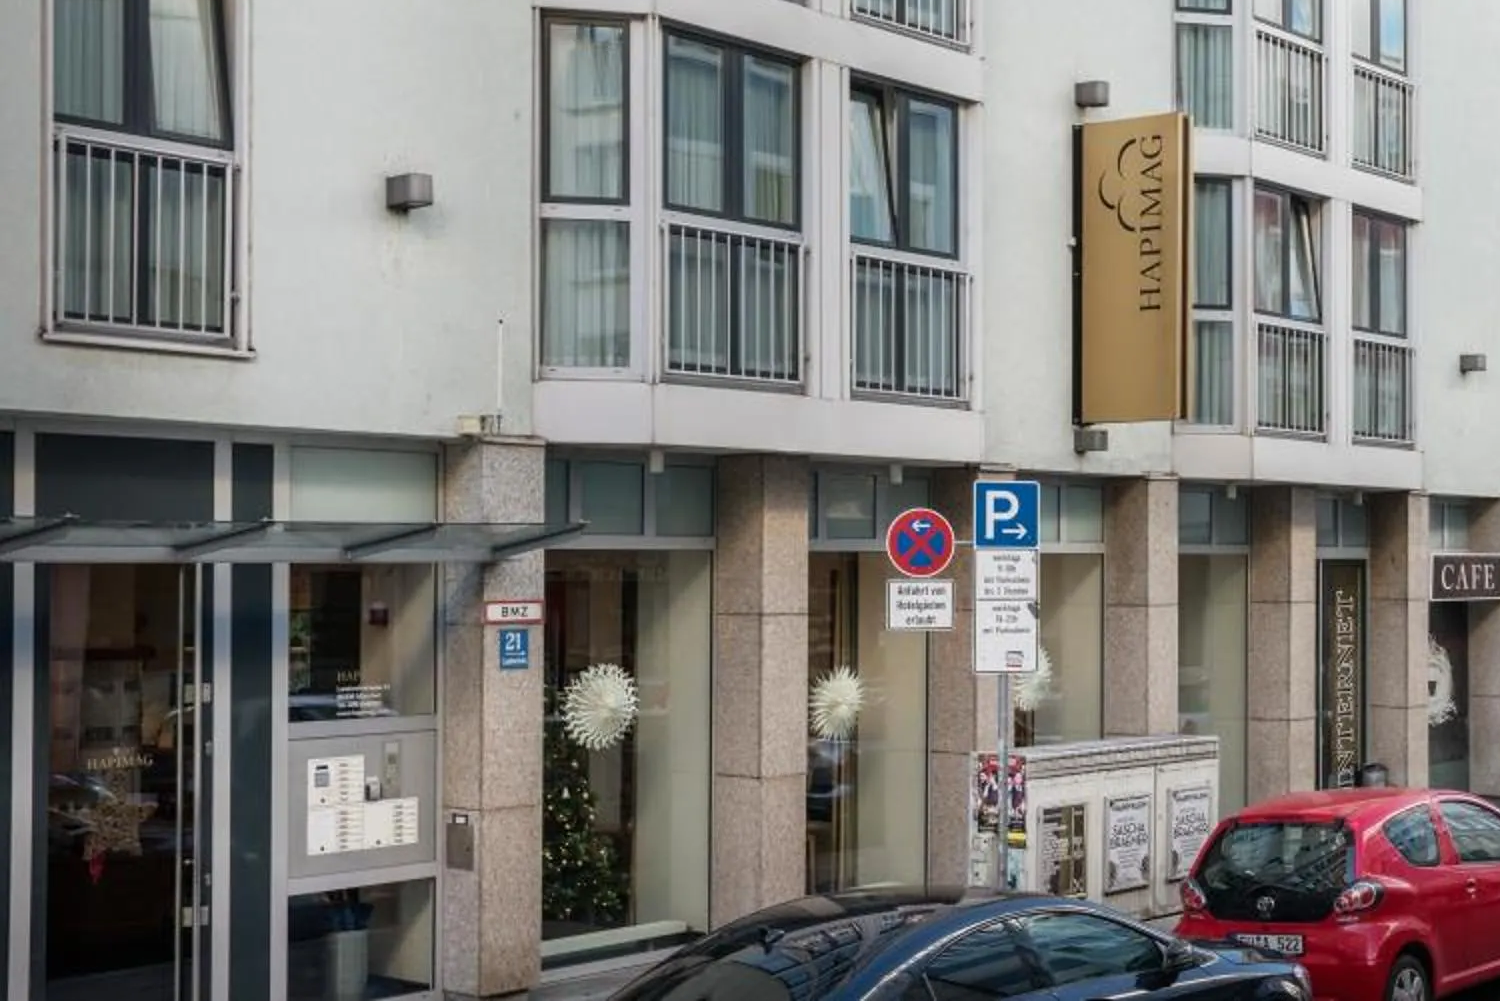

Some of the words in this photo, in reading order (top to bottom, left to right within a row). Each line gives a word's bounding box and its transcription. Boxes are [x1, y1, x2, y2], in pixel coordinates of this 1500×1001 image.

[1139, 134, 1164, 312] HAPIMAG
[985, 490, 1020, 540] P
[1441, 563, 1495, 590] CAFE
[501, 606, 528, 617] BMZ
[505, 631, 521, 651] 21
